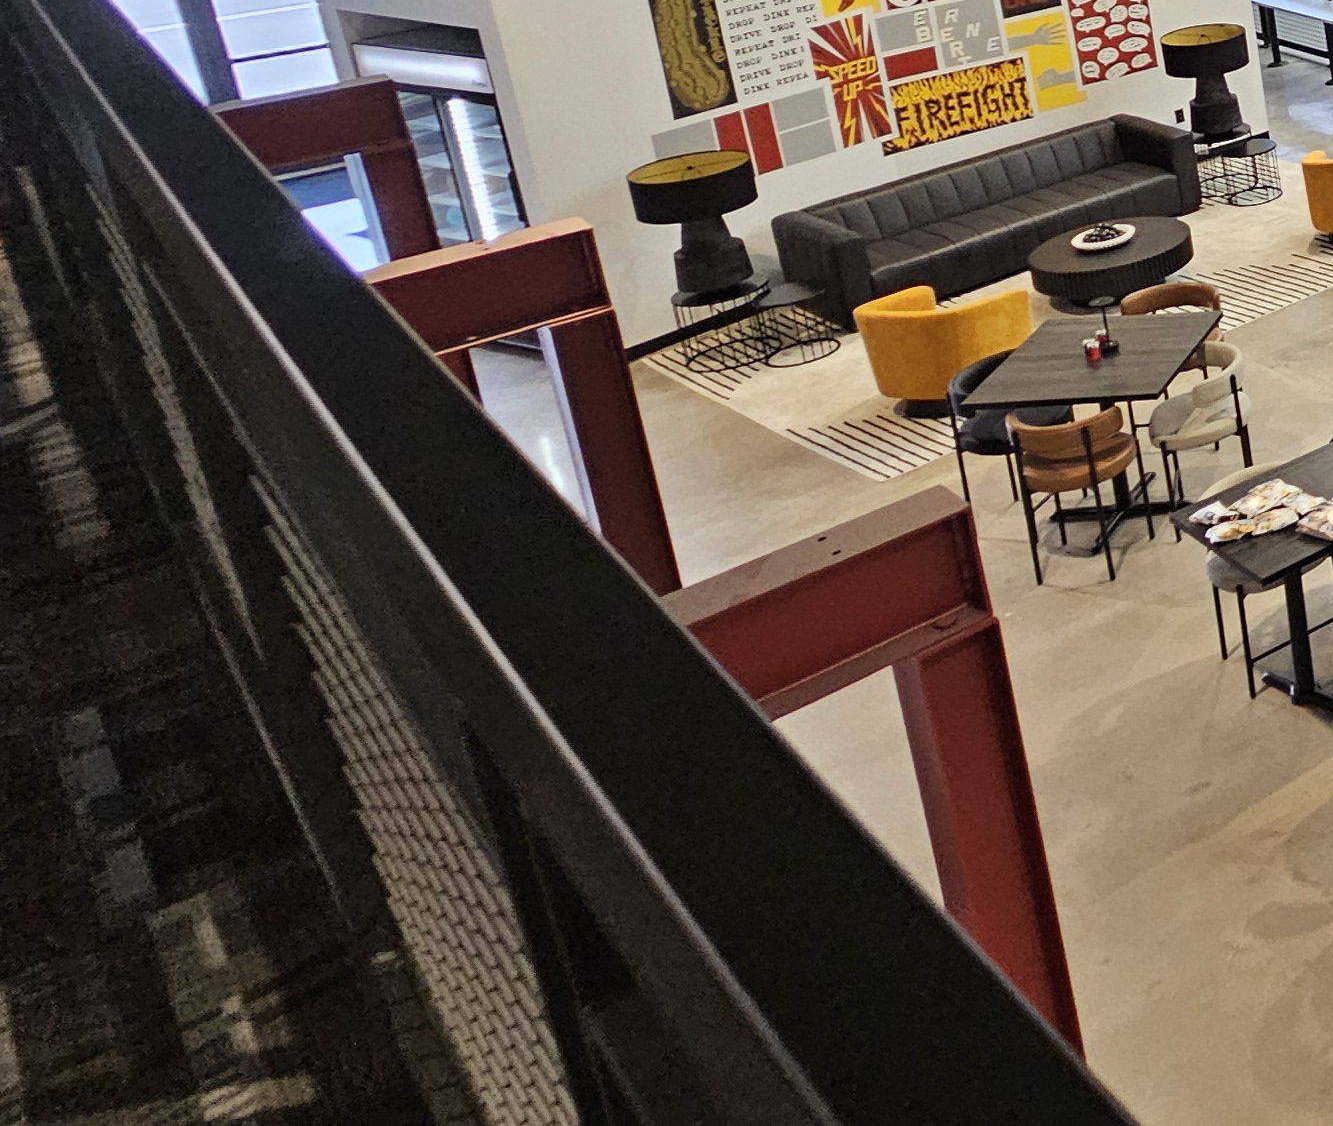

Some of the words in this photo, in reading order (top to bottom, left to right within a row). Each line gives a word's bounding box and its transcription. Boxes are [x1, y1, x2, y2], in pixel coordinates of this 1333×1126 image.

[725, 1, 766, 17] REPEAT
[728, 17, 755, 30] DROP
[763, 9, 790, 21] DINK
[729, 29, 763, 43] DRIVE
[770, 21, 795, 33] DROP
[734, 40, 775, 56] REPEAT
[736, 56, 763, 69] DROP
[771, 47, 797, 60] DINK
[739, 67, 772, 83] DRIVE
[779, 59, 805, 72] DROP
[822, 55, 877, 84] SPEED
[743, 82, 770, 95] DINK
[843, 79, 863, 102] UP
[894, 76, 1030, 138] FIREFIGHT
